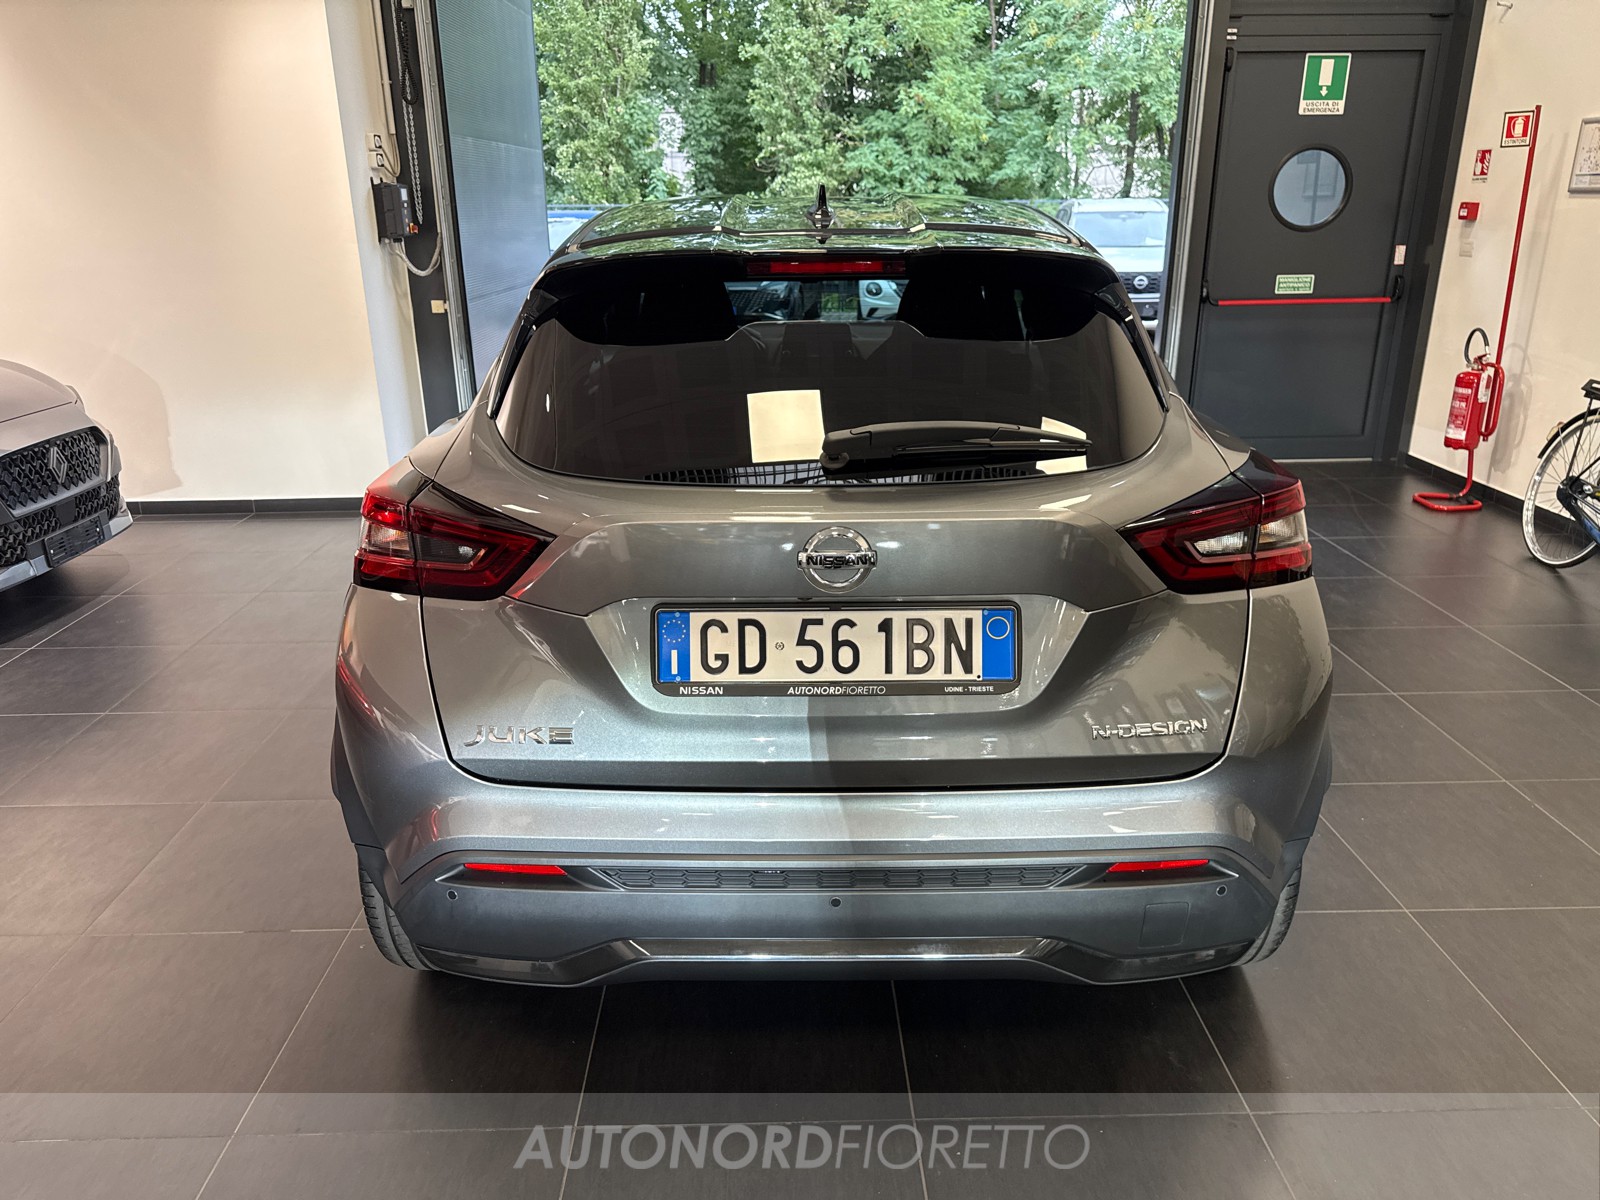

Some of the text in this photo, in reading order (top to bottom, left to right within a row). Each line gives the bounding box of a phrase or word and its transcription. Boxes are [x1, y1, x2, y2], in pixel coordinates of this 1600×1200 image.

[806, 554, 868, 566] NISSAN
[679, 686, 724, 695] NISSAN
[786, 685, 886, 695] AUTONORDFIORETTO
[1091, 718, 1208, 740] N-DESIGN
[463, 724, 575, 747] JUKE
